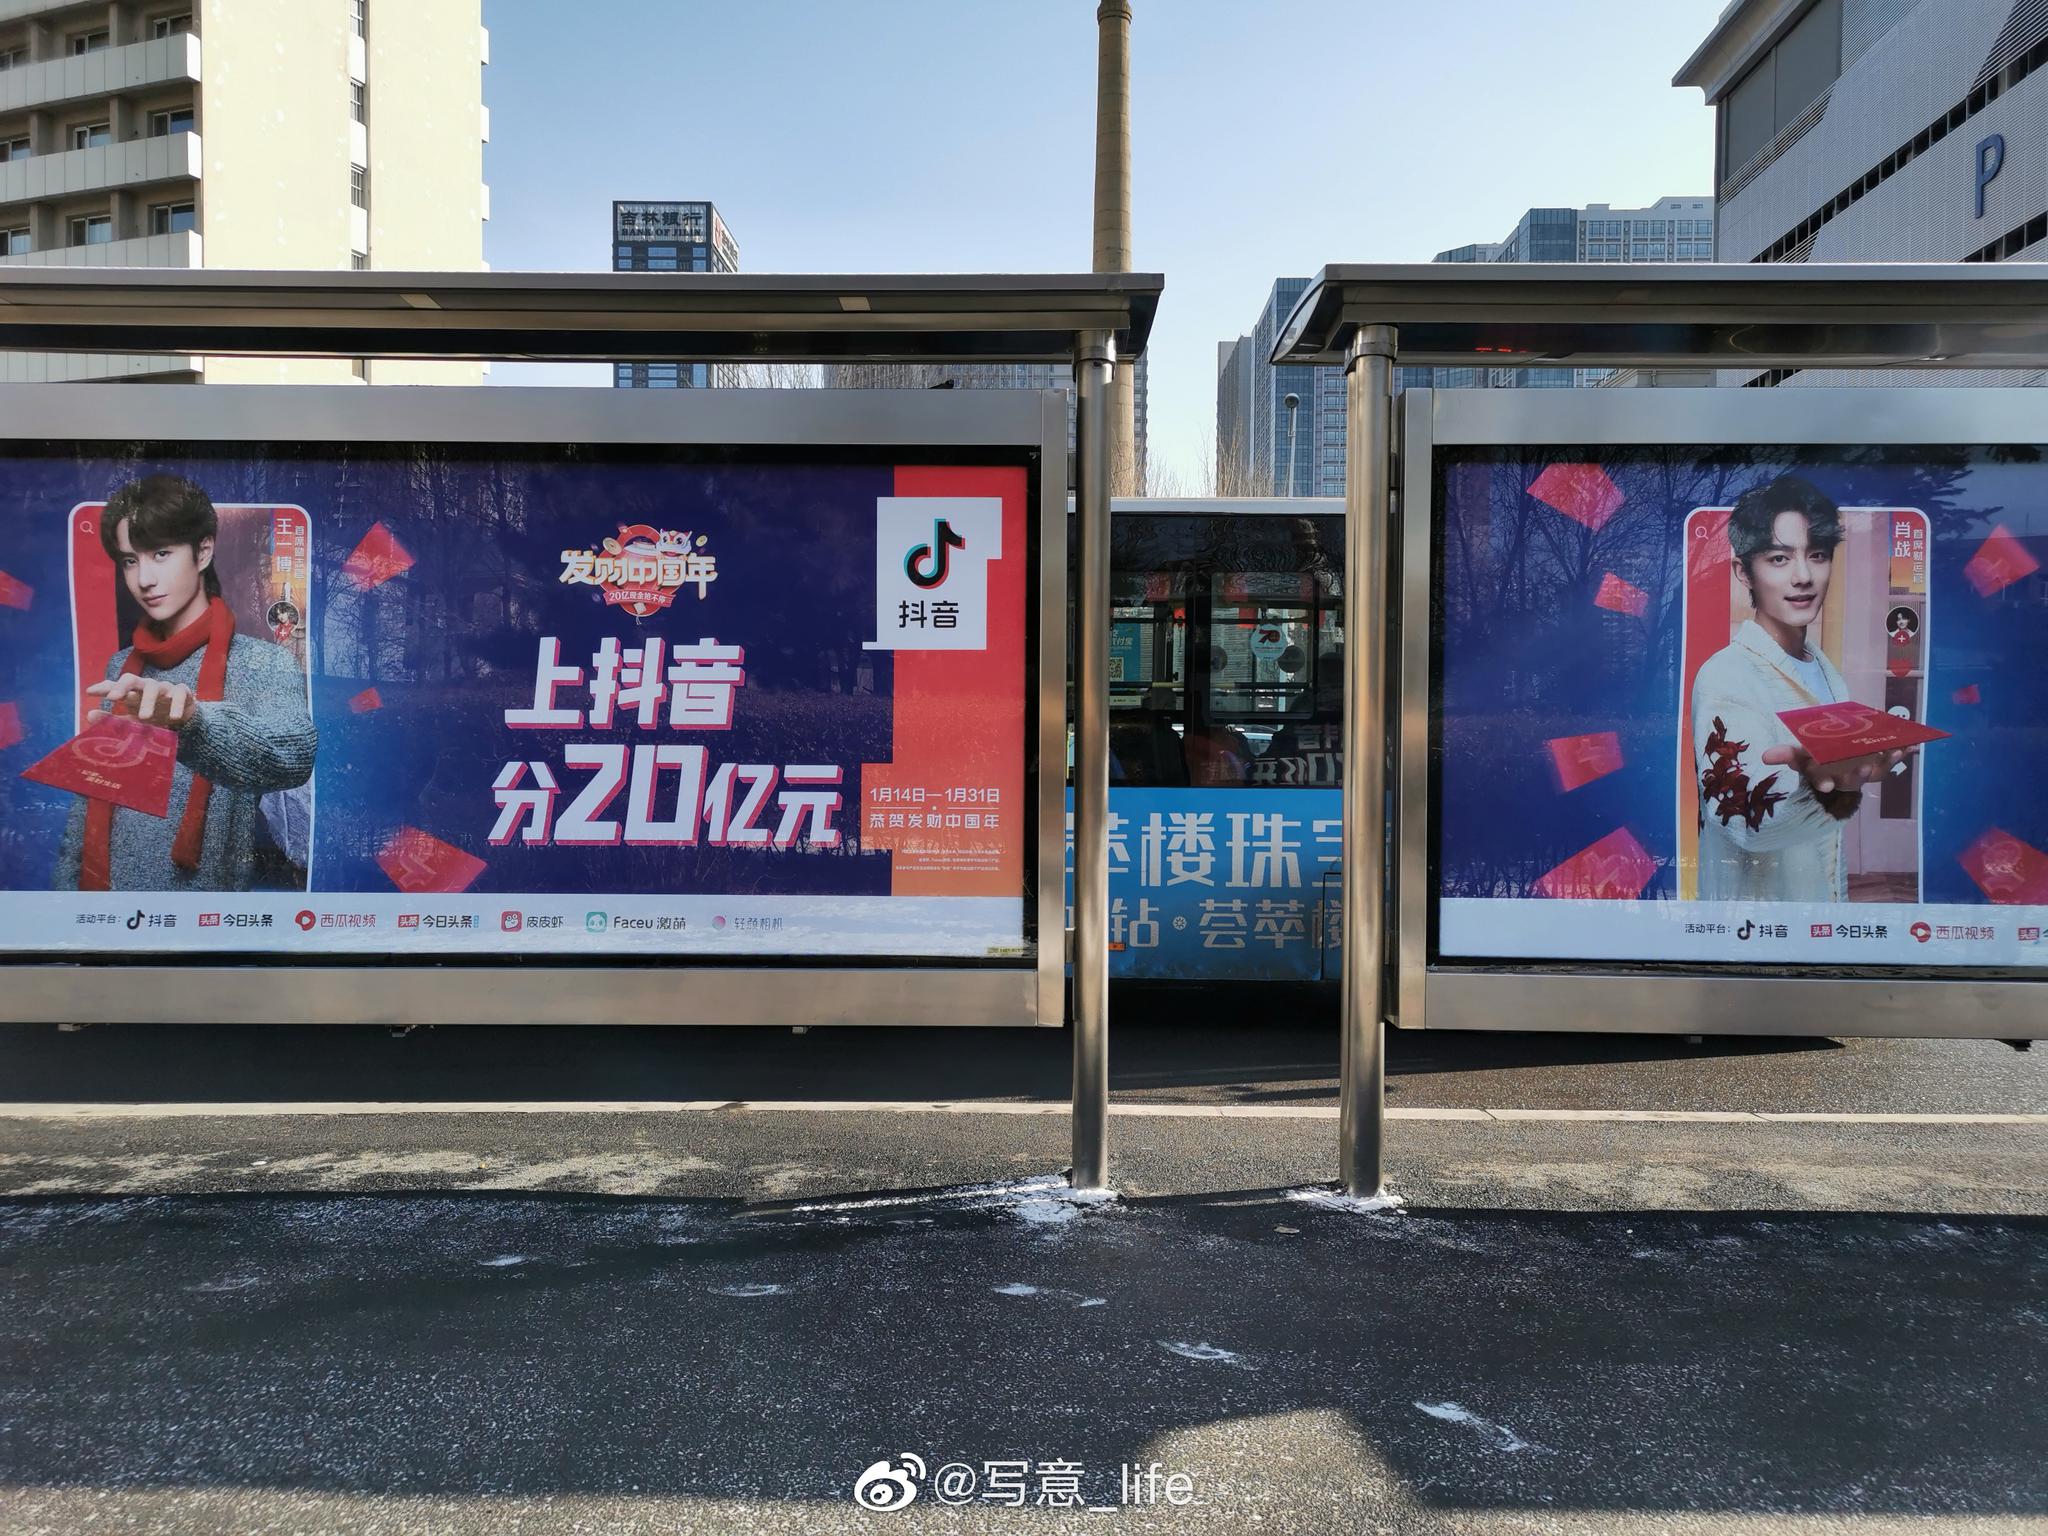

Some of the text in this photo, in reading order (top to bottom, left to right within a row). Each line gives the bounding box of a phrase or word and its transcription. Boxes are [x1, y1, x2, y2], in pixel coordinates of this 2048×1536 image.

[1974, 133, 2004, 219] P
[622, 228, 701, 237] BANK OF JILIN
[276, 518, 292, 572] 王一博
[1895, 521, 1911, 557] 肖战
[558, 549, 719, 600] 发财中国年
[898, 600, 959, 628] 抖音
[503, 636, 746, 731] 上抖音
[487, 744, 844, 847] 分20亿元
[869, 813, 1000, 829] 恭贺发财中国年
[148, 914, 178, 928] 抖音
[223, 914, 273, 927] 今日头条
[320, 914, 377, 928] 西瓜视频
[422, 915, 473, 928] 今日头条
[613, 916, 653, 929] Faceu
[1759, 924, 1788, 938] 抖音
[1835, 924, 1888, 938] 今日头条
[1936, 926, 1995, 940] 西瓜视频
